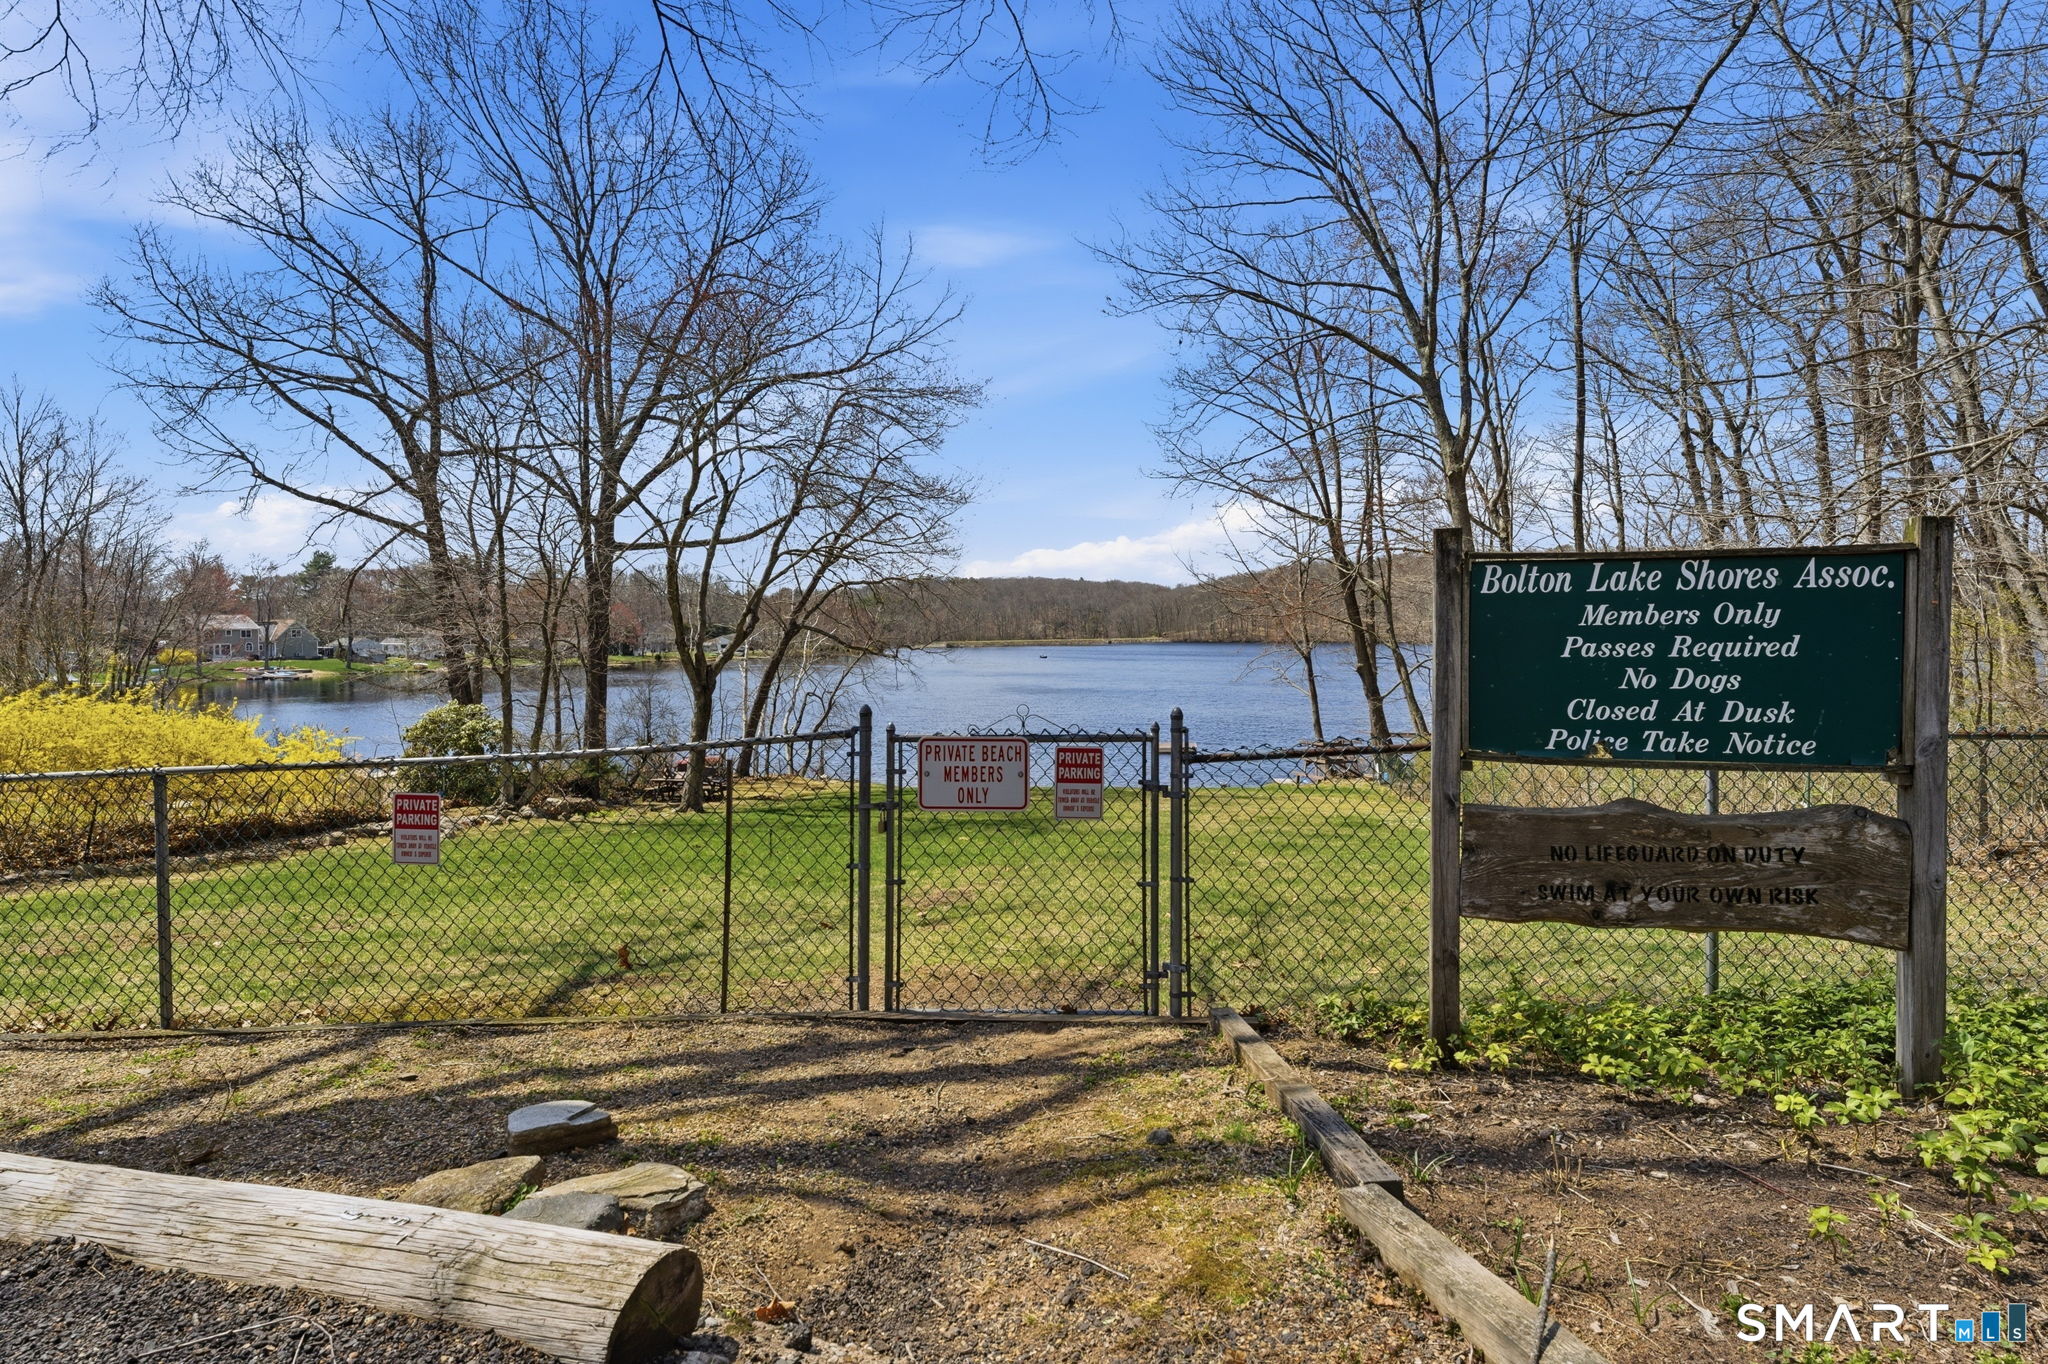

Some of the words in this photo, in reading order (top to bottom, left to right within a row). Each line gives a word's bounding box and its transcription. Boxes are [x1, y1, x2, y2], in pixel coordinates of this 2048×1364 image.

[1480, 563, 1573, 594] Bolton
[1586, 561, 1662, 592] Lake
[1676, 559, 1779, 591] Shores
[1794, 556, 1895, 589] Assoc.
[1577, 603, 1701, 626] Members
[1713, 601, 1782, 629] Only
[1560, 636, 1656, 658] Passes
[1667, 634, 1801, 662] Required
[1617, 667, 1657, 690] No
[1669, 667, 1742, 693] Dogs
[1567, 698, 1658, 722] Closed
[1671, 701, 1706, 722] At
[1718, 700, 1796, 724] Dusk
[1642, 730, 1710, 754] Take
[1722, 731, 1817, 756] Notice
[925, 745, 976, 762] PRIVATE
[981, 745, 1022, 762] BEACH
[1058, 752, 1101, 765] PRIVATE
[944, 766, 1003, 783] MEMBERS
[1058, 767, 1101, 780] PARKING
[396, 799, 438, 811] PRIVATE
[957, 787, 989, 804] ONLY
[396, 814, 438, 826] PARKING
[1550, 845, 1577, 862] NO
[1585, 845, 1700, 863] LIFEGUARD
[1707, 846, 1737, 863] ON
[1744, 846, 1806, 864] DUTY
[1537, 884, 1595, 901] SWIM
[1603, 884, 1632, 902] AT
[1640, 886, 1700, 903] YOUR
[1709, 887, 1762, 904] OWN
[1769, 888, 1820, 905] RISK
